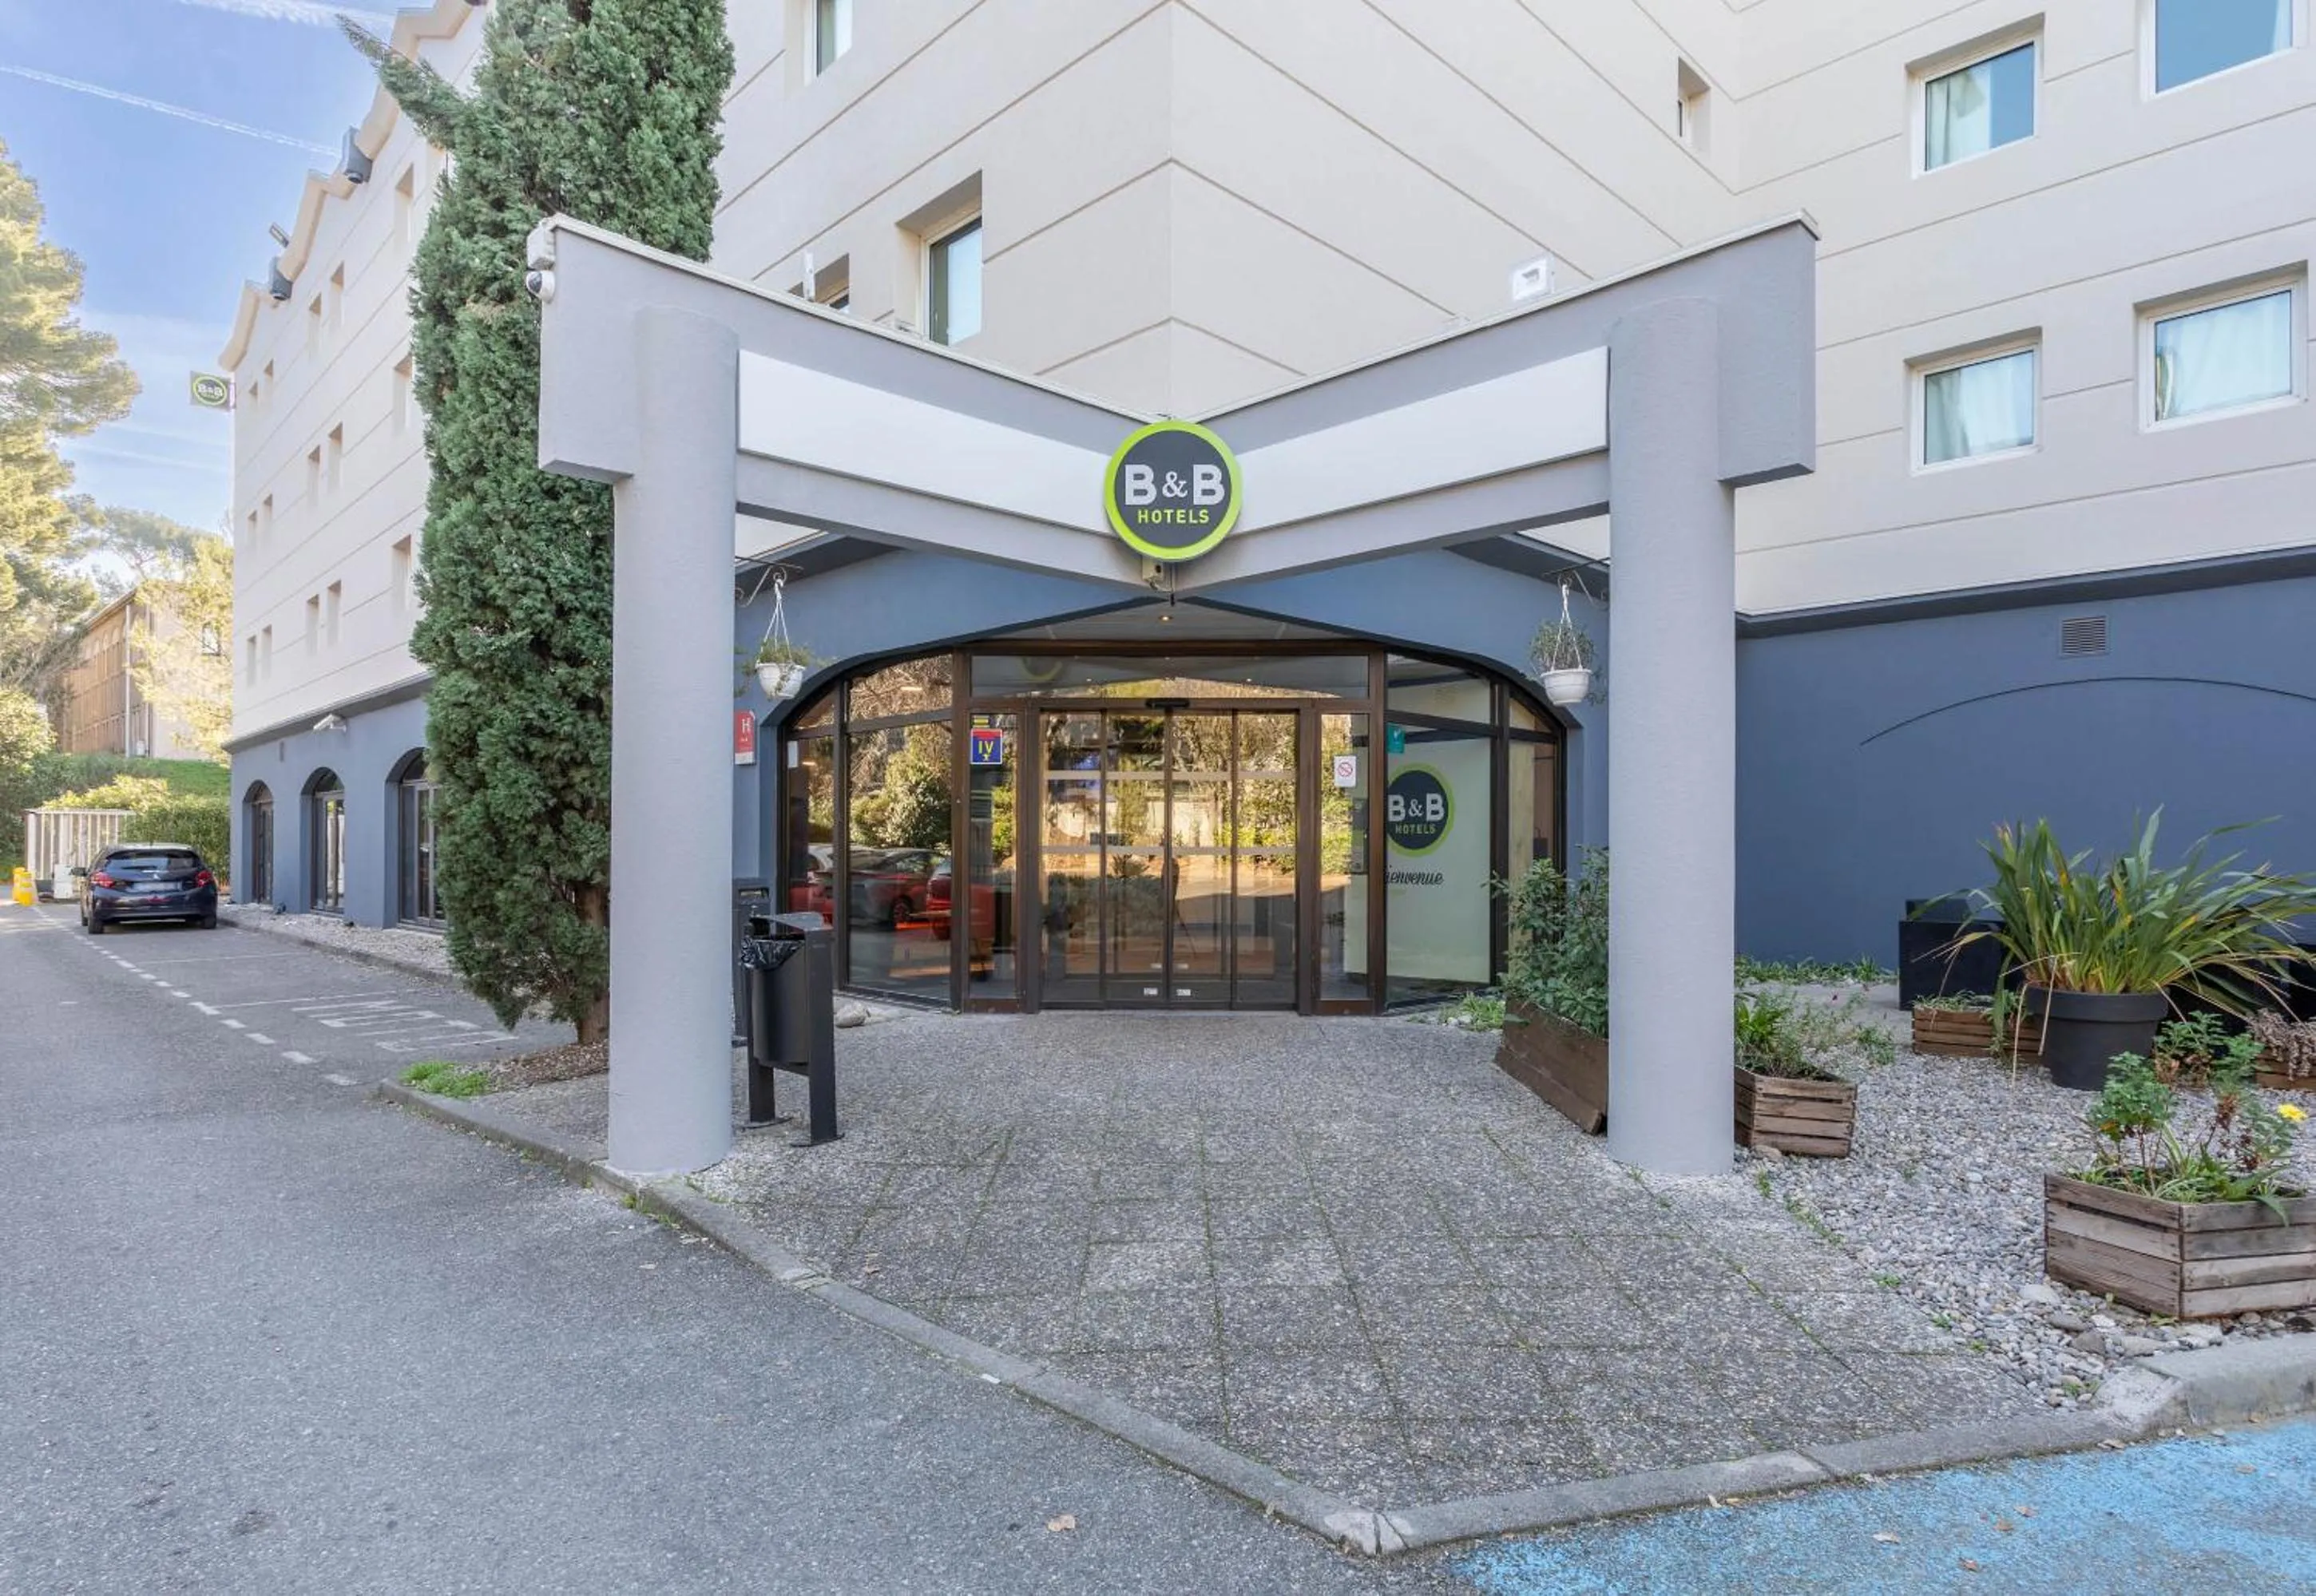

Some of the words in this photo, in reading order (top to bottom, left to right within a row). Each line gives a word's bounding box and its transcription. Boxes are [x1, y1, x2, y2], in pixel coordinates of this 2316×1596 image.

[1124, 464, 1225, 505] B&B
[1137, 509, 1210, 525] HOTELS
[1388, 793, 1445, 822] B&B
[1394, 823, 1437, 835] HOTELS
[1385, 865, 1444, 885] ienvenue
